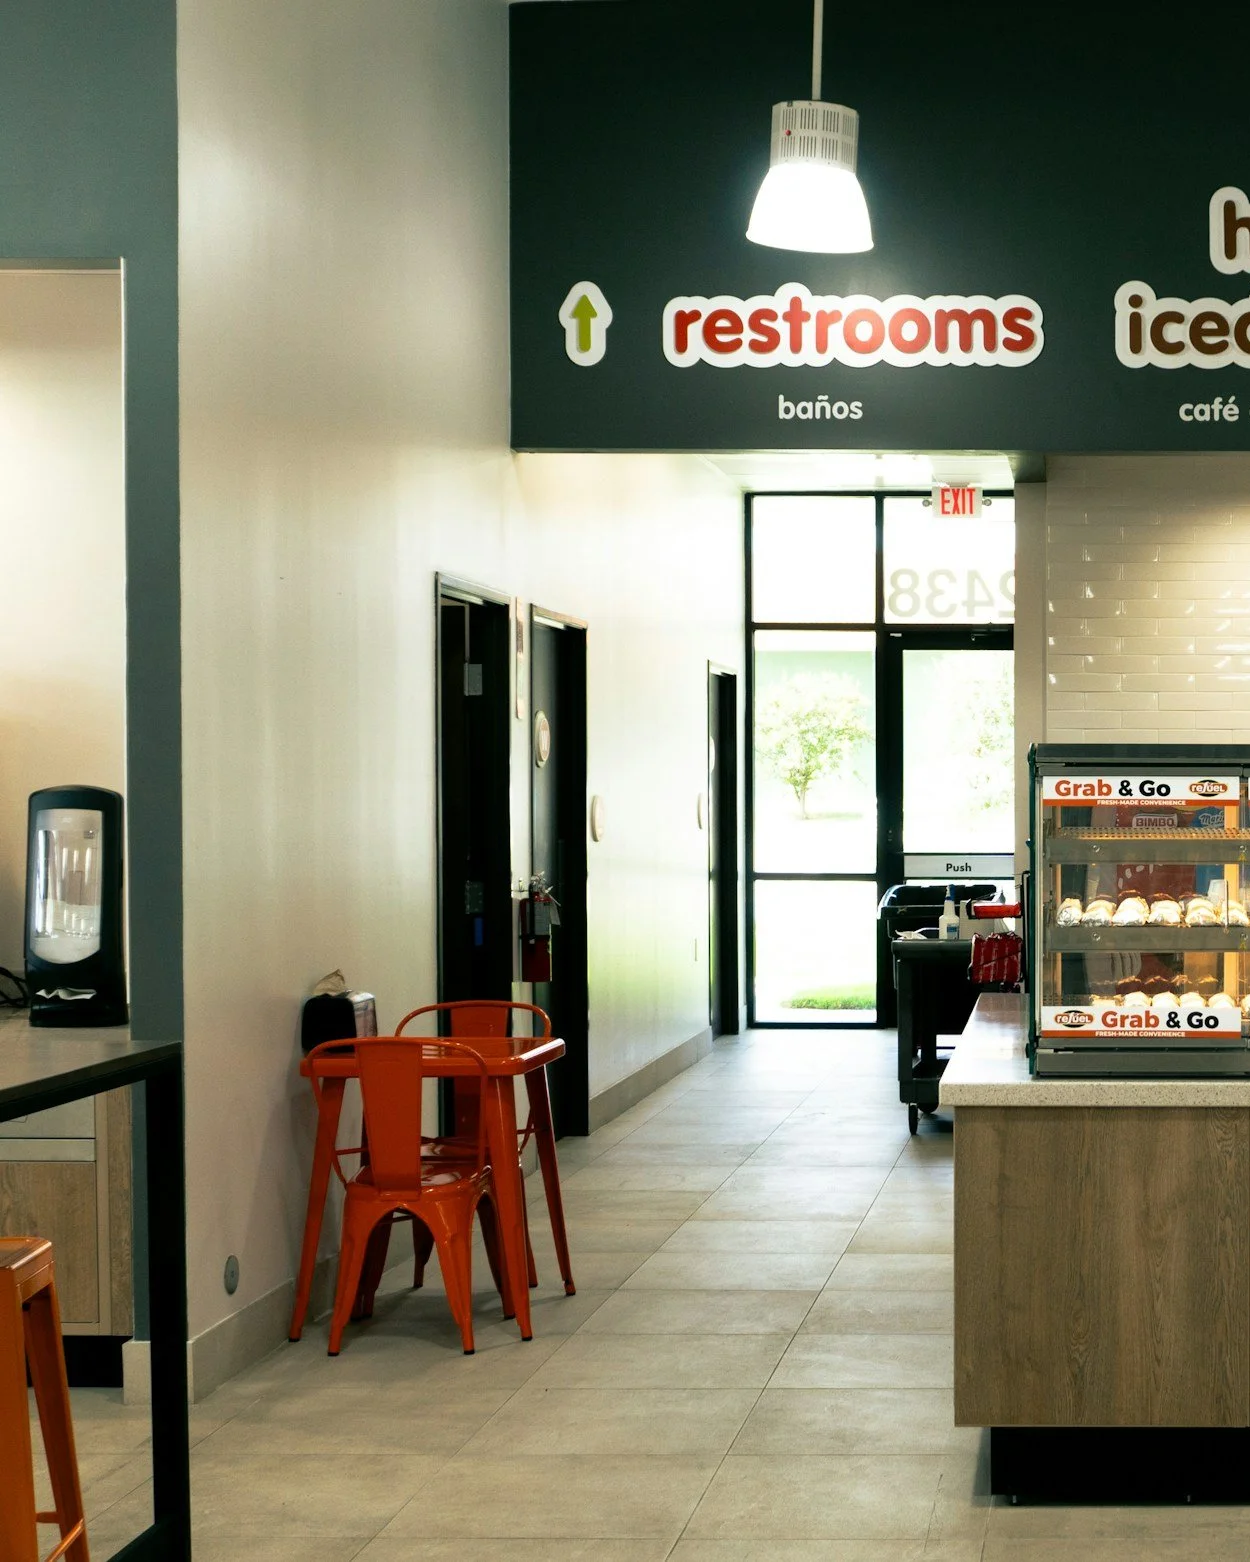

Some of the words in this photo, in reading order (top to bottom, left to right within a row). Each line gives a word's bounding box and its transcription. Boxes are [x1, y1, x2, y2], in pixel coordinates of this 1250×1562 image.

[674, 295, 1035, 354] restrooms
[778, 394, 863, 420] baños
[1178, 395, 1240, 422] café
[940, 488, 976, 515] EXIT
[1055, 779, 1112, 797] Grab
[1118, 779, 1133, 797] &
[1139, 780, 1171, 797] Go
[1135, 817, 1175, 827] BIMBO
[946, 863, 972, 872] Push
[1101, 1011, 1160, 1028] Grab
[1166, 1011, 1181, 1029] &
[1187, 1012, 1219, 1029] Go
